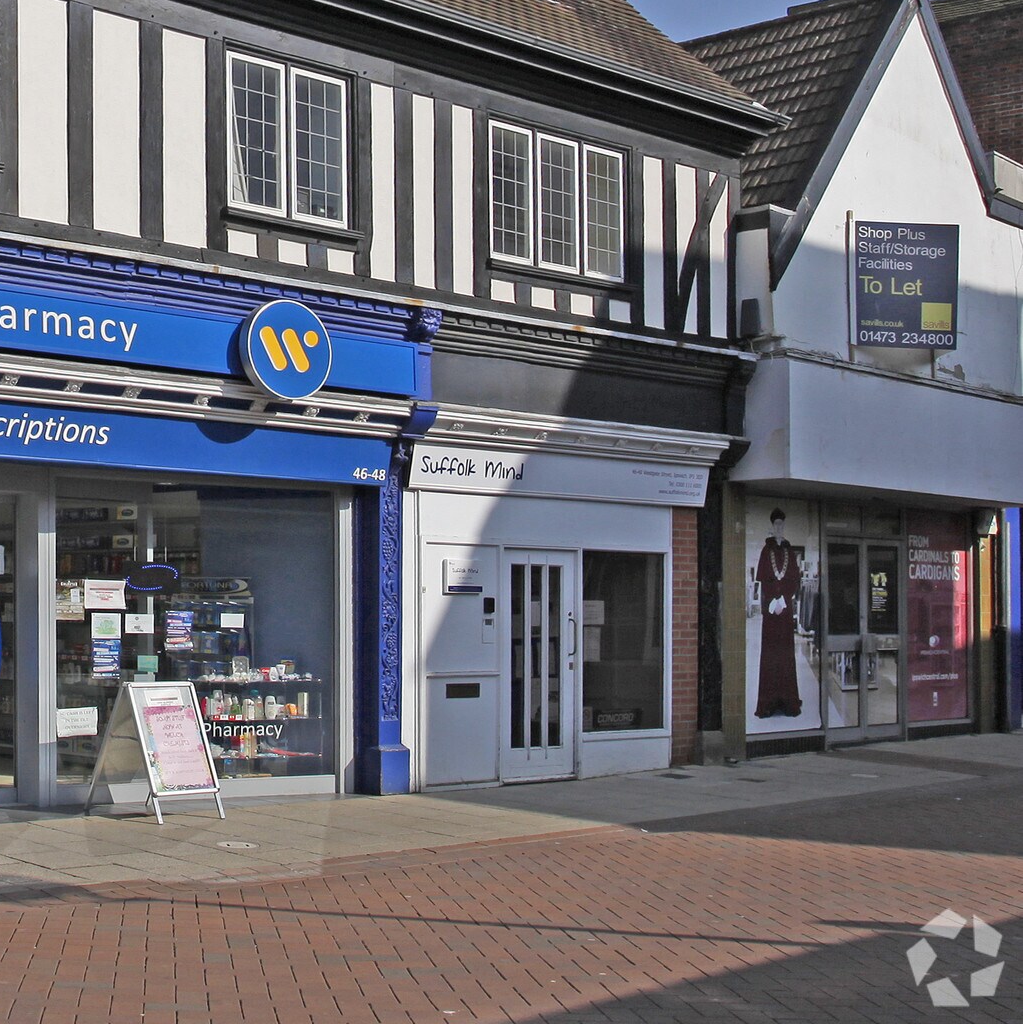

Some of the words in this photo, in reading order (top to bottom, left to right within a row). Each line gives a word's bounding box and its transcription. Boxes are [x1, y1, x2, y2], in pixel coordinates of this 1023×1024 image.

[858, 226, 892, 241] Shop
[897, 228, 926, 240] Plus
[858, 241, 946, 259] Staff/Storage
[858, 257, 913, 271] Facilities
[859, 275, 882, 294] To
[890, 277, 923, 296] Let
[922, 320, 950, 329] savills
[859, 330, 896, 343] 01473
[901, 332, 954, 346] 234800
[352, 467, 386, 481] 46-48
[420, 456, 476, 477] Suffolk
[484, 460, 524, 481] Mind
[908, 535, 929, 547] FROM
[908, 549, 948, 563] CARDINALS
[951, 552, 960, 564] TO
[908, 564, 960, 581] CARDIGANS
[203, 721, 283, 739] Pharmacy
